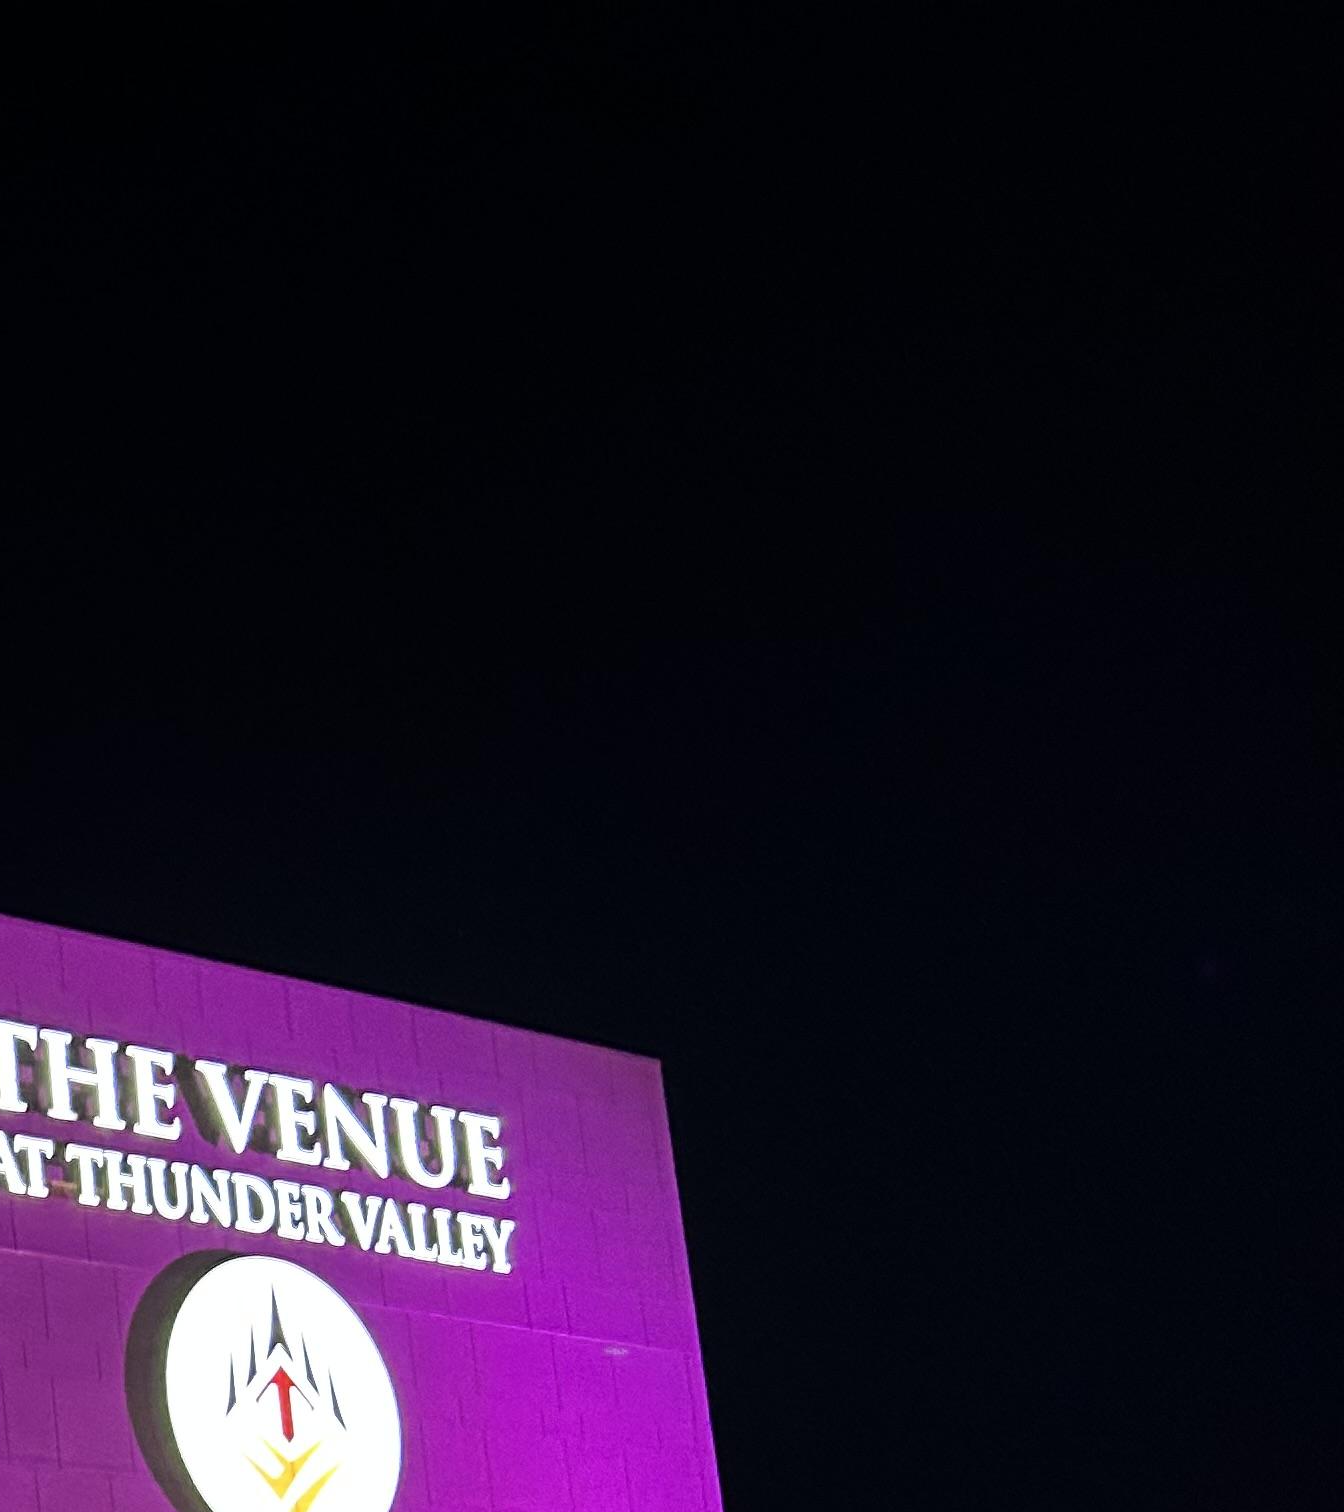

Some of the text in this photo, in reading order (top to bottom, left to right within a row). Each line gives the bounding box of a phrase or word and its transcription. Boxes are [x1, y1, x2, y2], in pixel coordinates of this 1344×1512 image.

[194, 1059, 511, 1200] VENUE
[64, 1143, 346, 1248] THUNDER
[340, 1191, 516, 1275] VALLEY
